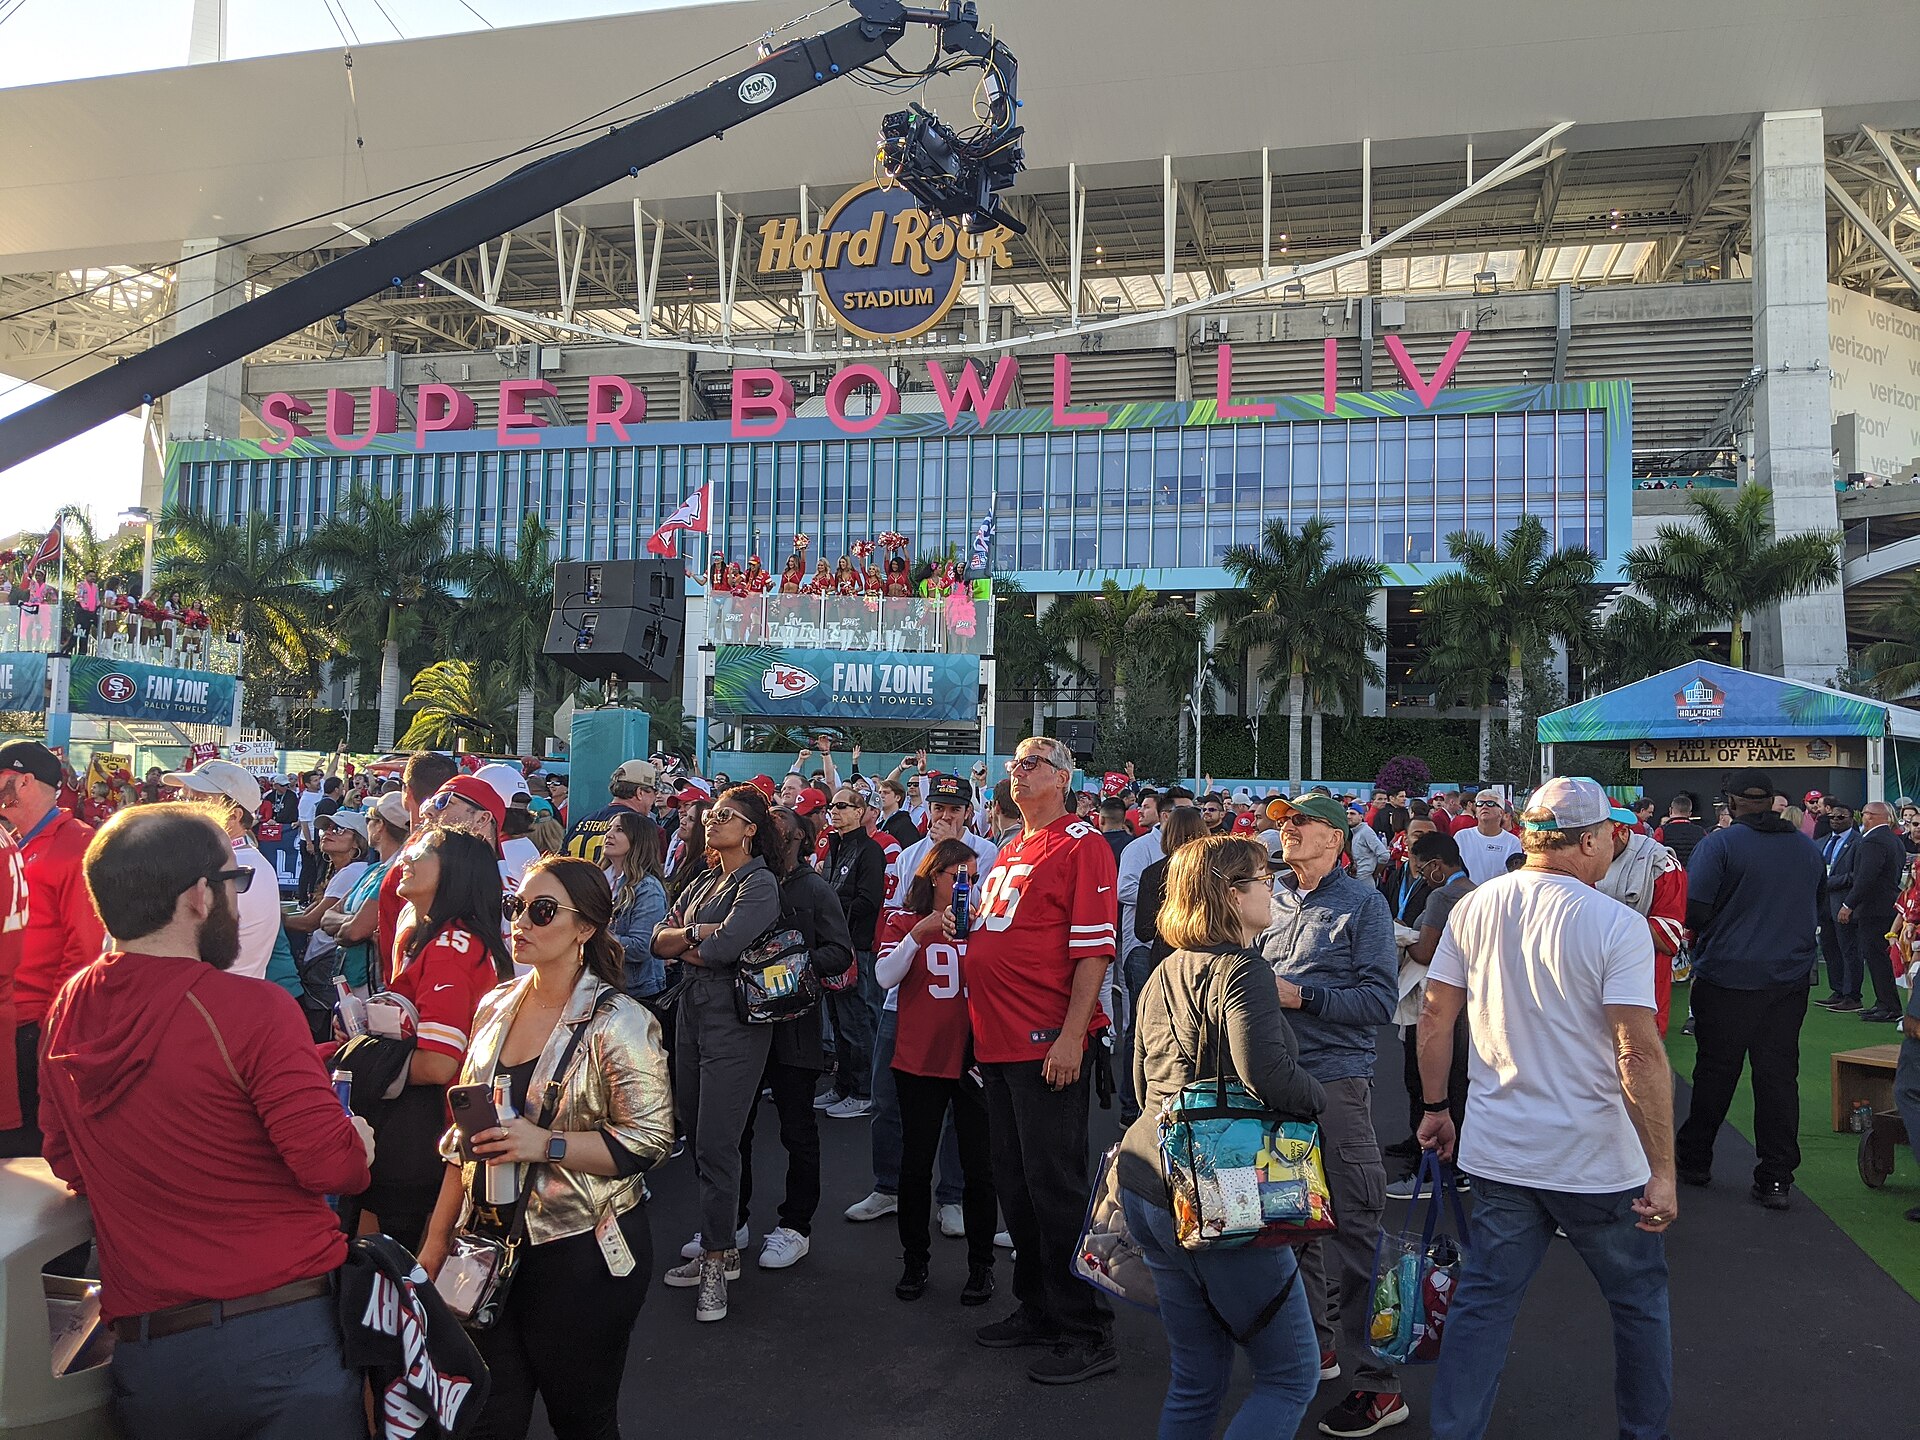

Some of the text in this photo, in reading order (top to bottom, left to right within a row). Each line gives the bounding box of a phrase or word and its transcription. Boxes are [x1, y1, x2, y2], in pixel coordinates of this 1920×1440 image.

[745, 77, 768, 95] FOX
[757, 211, 886, 273] Hard
[843, 287, 934, 309] STADIUM
[1828, 332, 1883, 366] verizon
[259, 331, 1471, 455] SUPER BOWL LIV
[832, 662, 934, 695] FAN ZONE
[145, 675, 210, 706] FAN ZONE
[832, 694, 934, 706] RALLY TOWELS
[144, 700, 207, 715] RALLY TOWELS
[1679, 709, 1698, 717] HALL
[1702, 708, 1721, 717] FAME
[1678, 737, 1782, 750] PRO FOOTBALL
[1665, 749, 1711, 763] HALL
[1717, 749, 1740, 762] OF
[1747, 748, 1796, 761] FAME
[435, 930, 472, 954] 15
